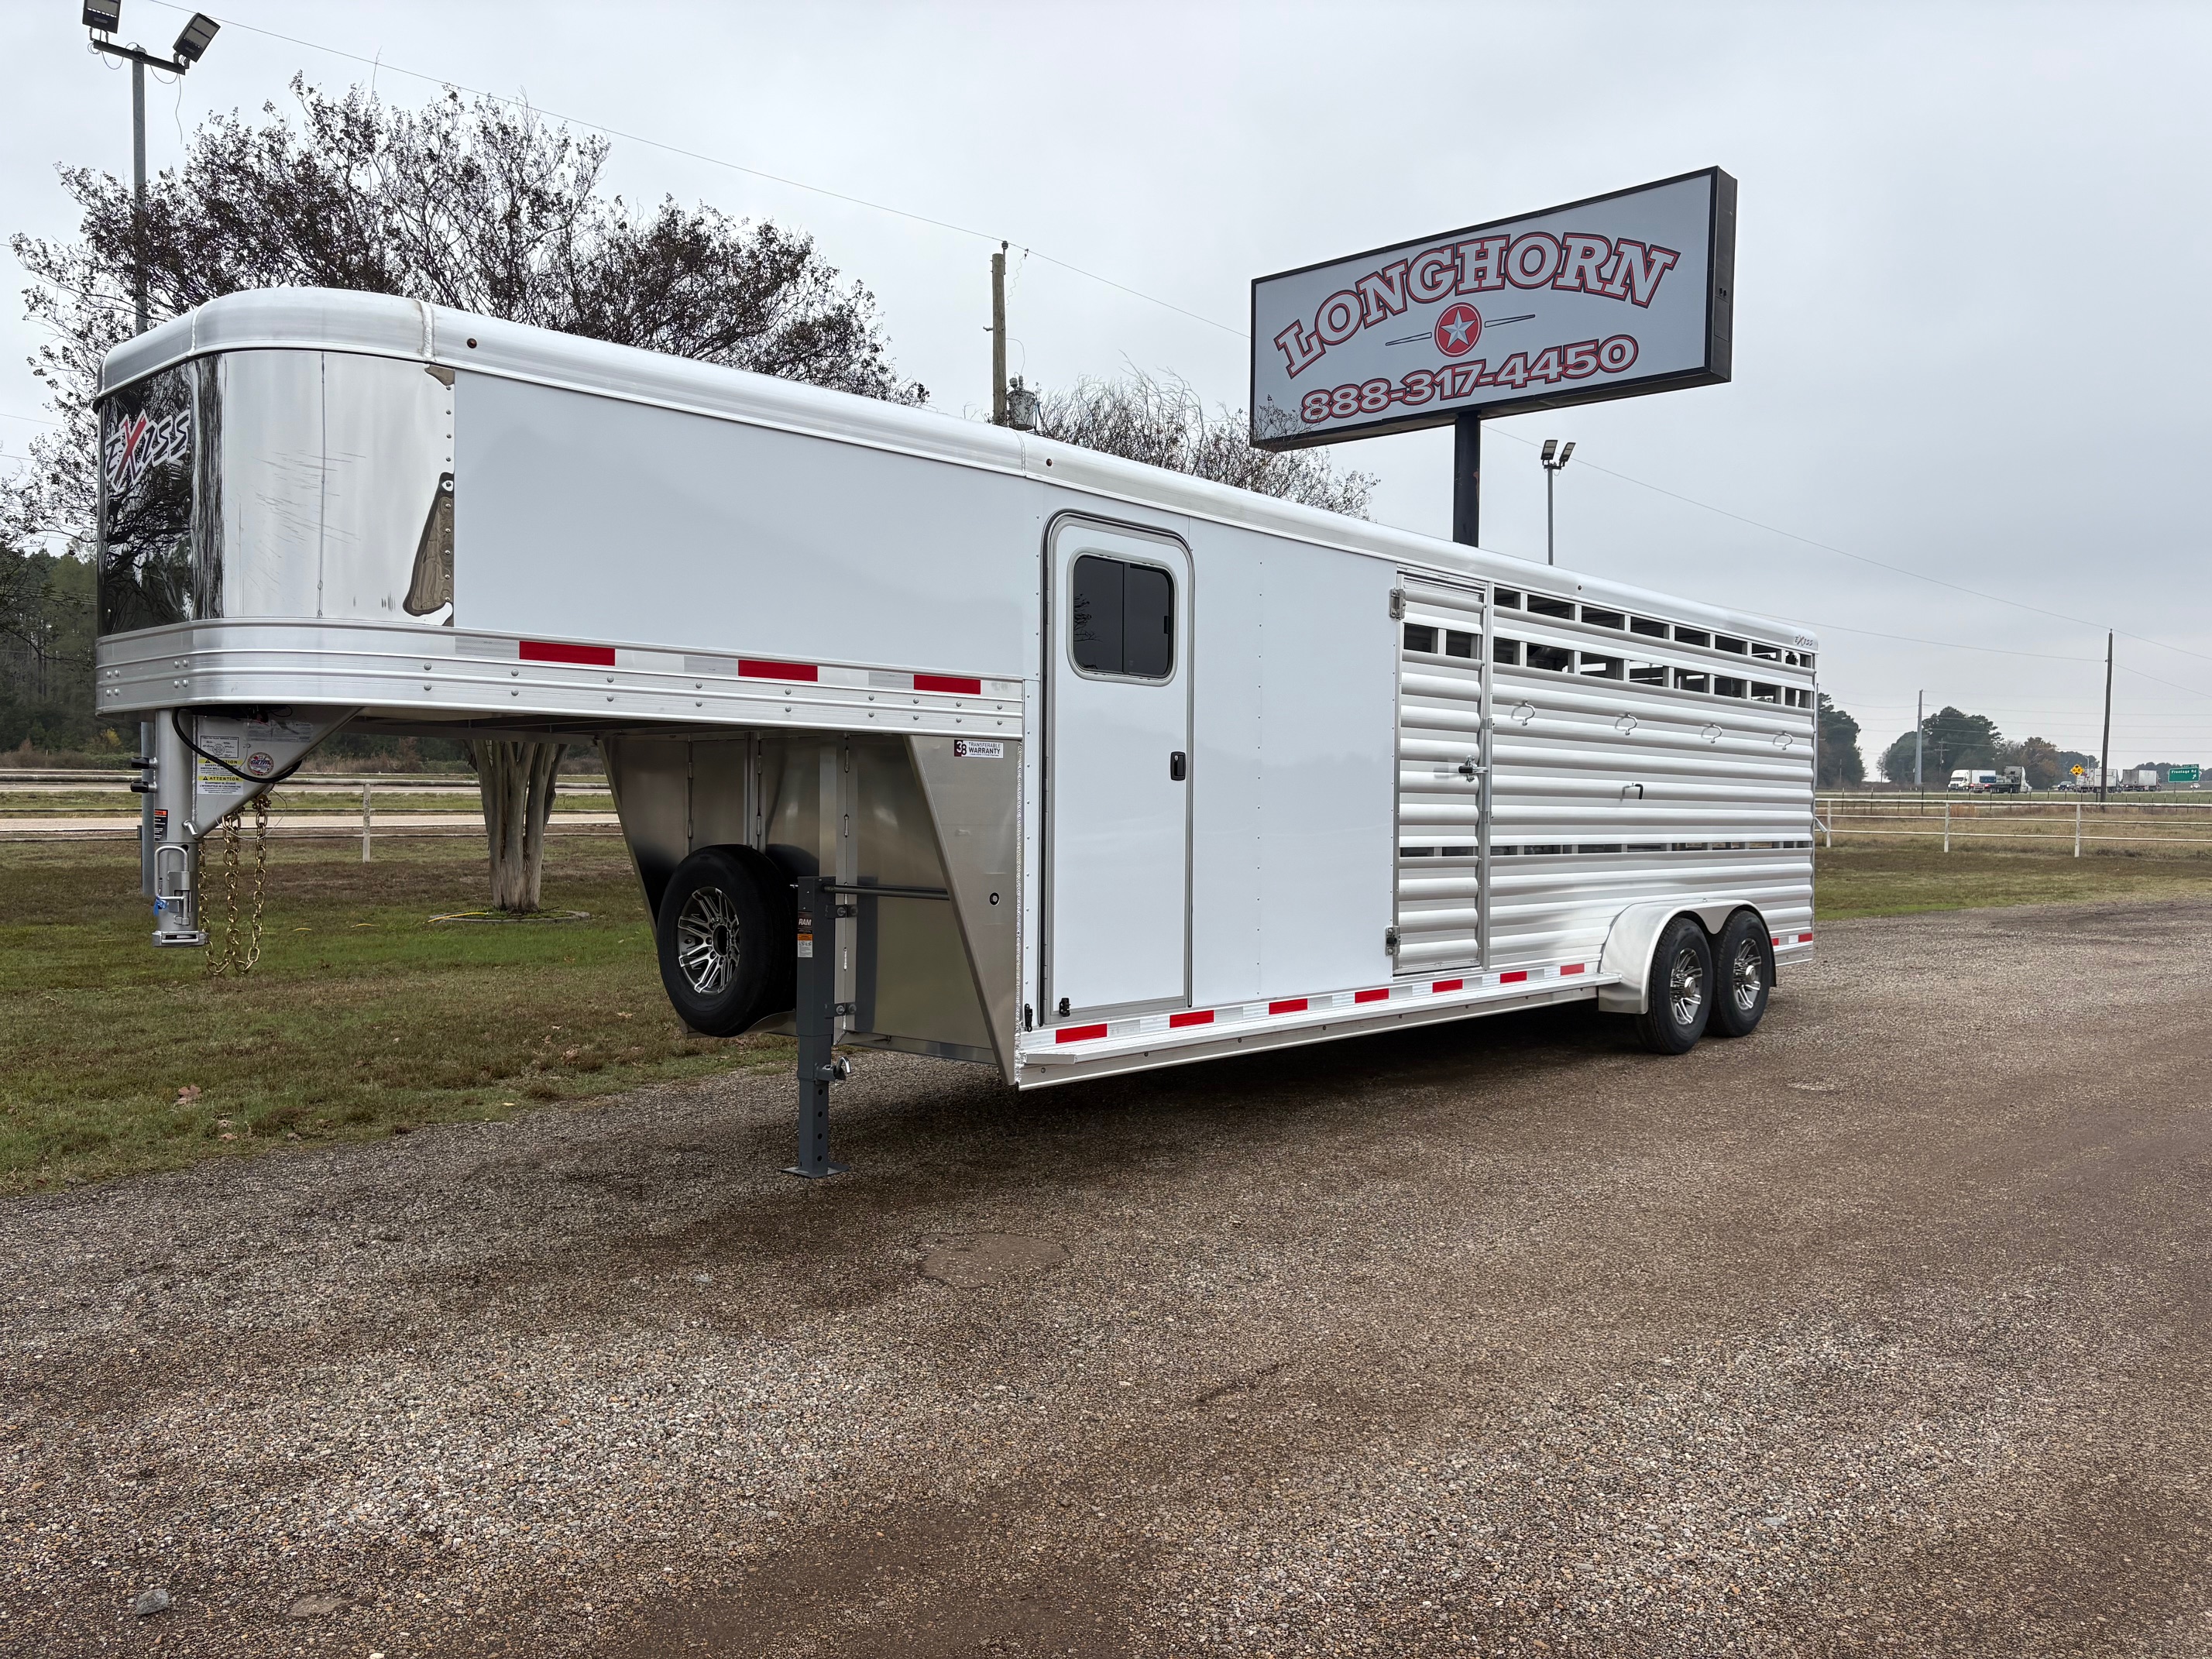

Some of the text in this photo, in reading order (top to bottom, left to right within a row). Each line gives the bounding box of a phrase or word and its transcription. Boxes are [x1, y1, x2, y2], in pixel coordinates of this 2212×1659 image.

[1273, 231, 1681, 380] LONGHORN
[1300, 334, 1639, 423] 888-317-4450
[105, 409, 191, 492] EXISS
[799, 918, 812, 926] RAM
